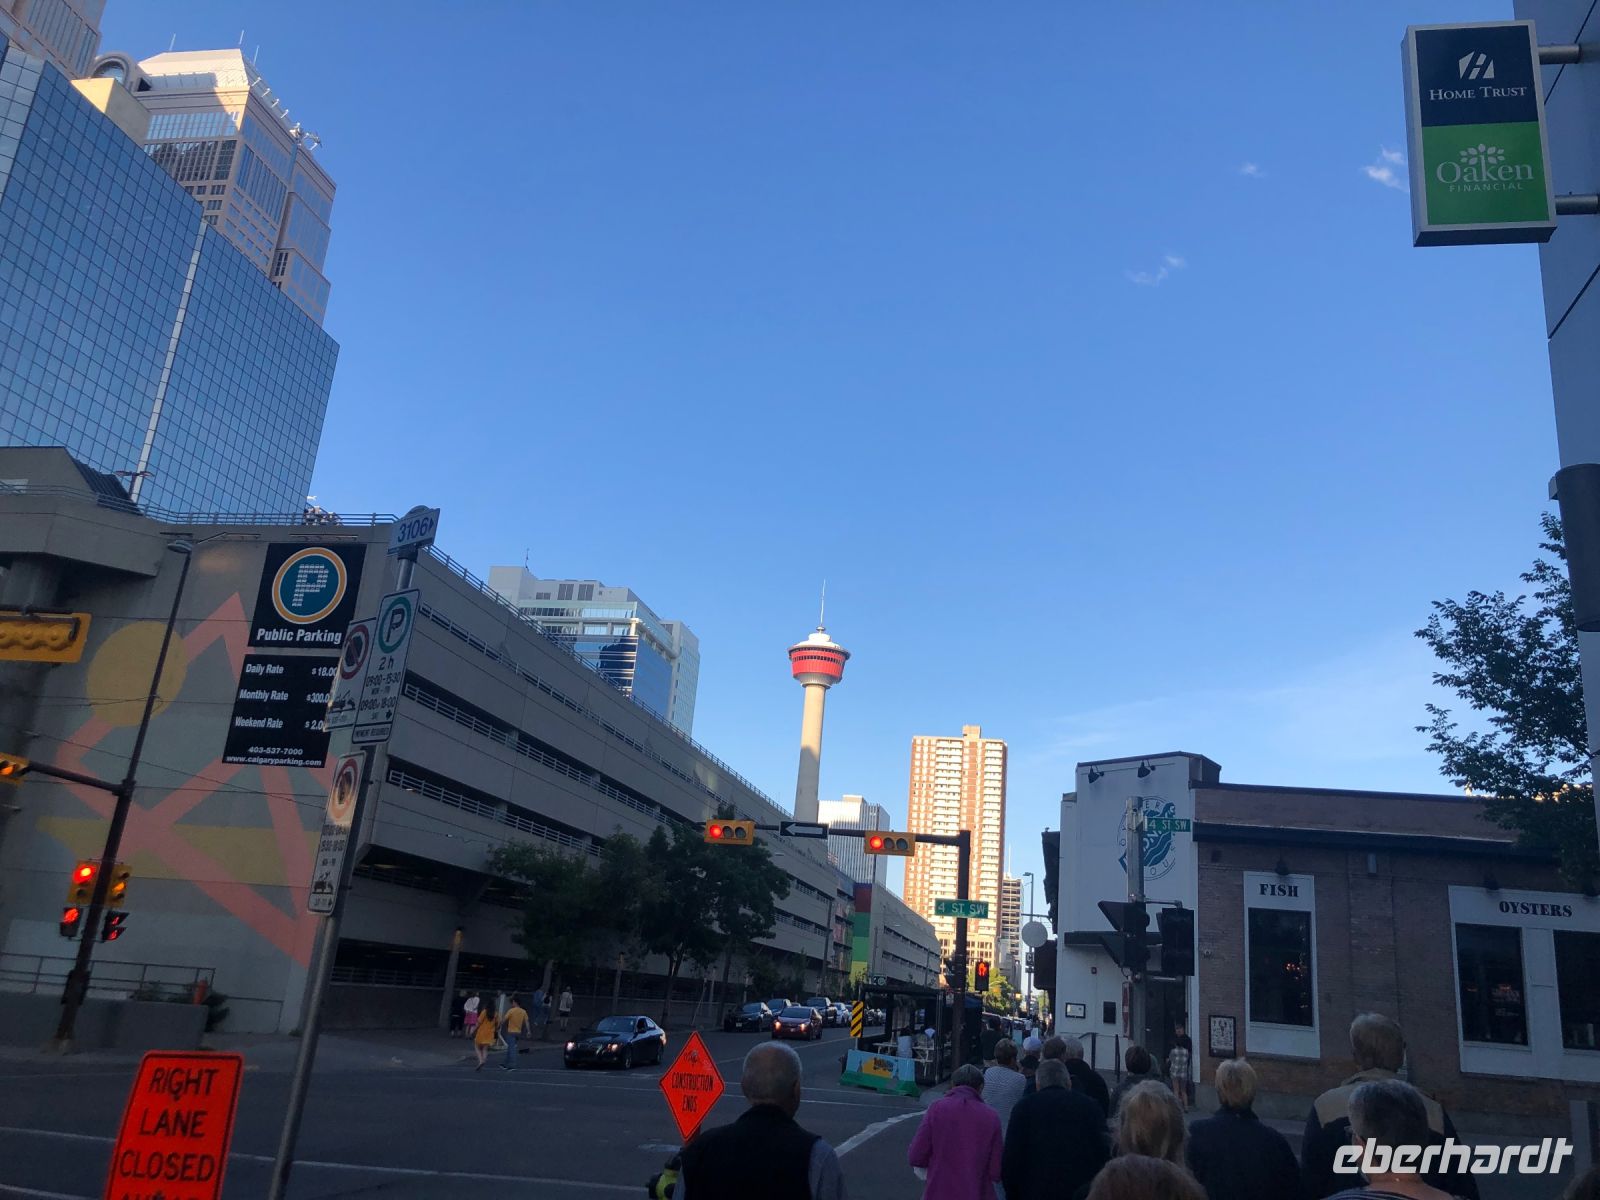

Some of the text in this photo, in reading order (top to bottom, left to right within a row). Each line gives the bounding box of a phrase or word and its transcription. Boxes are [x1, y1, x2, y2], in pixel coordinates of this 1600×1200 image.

[1429, 86, 1528, 101] HOME TRUST
[1436, 153, 1535, 184] Oaken
[1449, 183, 1524, 192] FINANCIAL
[397, 517, 429, 542] 3106
[256, 629, 342, 644] Public Parking
[245, 664, 284, 675] Daily Rate
[240, 689, 288, 702] Monthly Rate
[235, 716, 284, 729] Weekend Rate
[248, 746, 304, 756] 403-537-7000
[226, 755, 322, 767] www.calgaryparking.com
[1162, 820, 1171, 830] ST
[1175, 820, 1187, 830] SW
[1259, 883, 1299, 898] FISH
[938, 901, 986, 916] 4 ST SW
[1500, 900, 1573, 918] OYSTERS
[149, 1067, 219, 1096] RIGHT
[671, 1072, 714, 1092] CONSTRUCTION
[682, 1094, 698, 1112] ENDS
[139, 1108, 208, 1138] LANE
[119, 1149, 215, 1182] CLOSED
